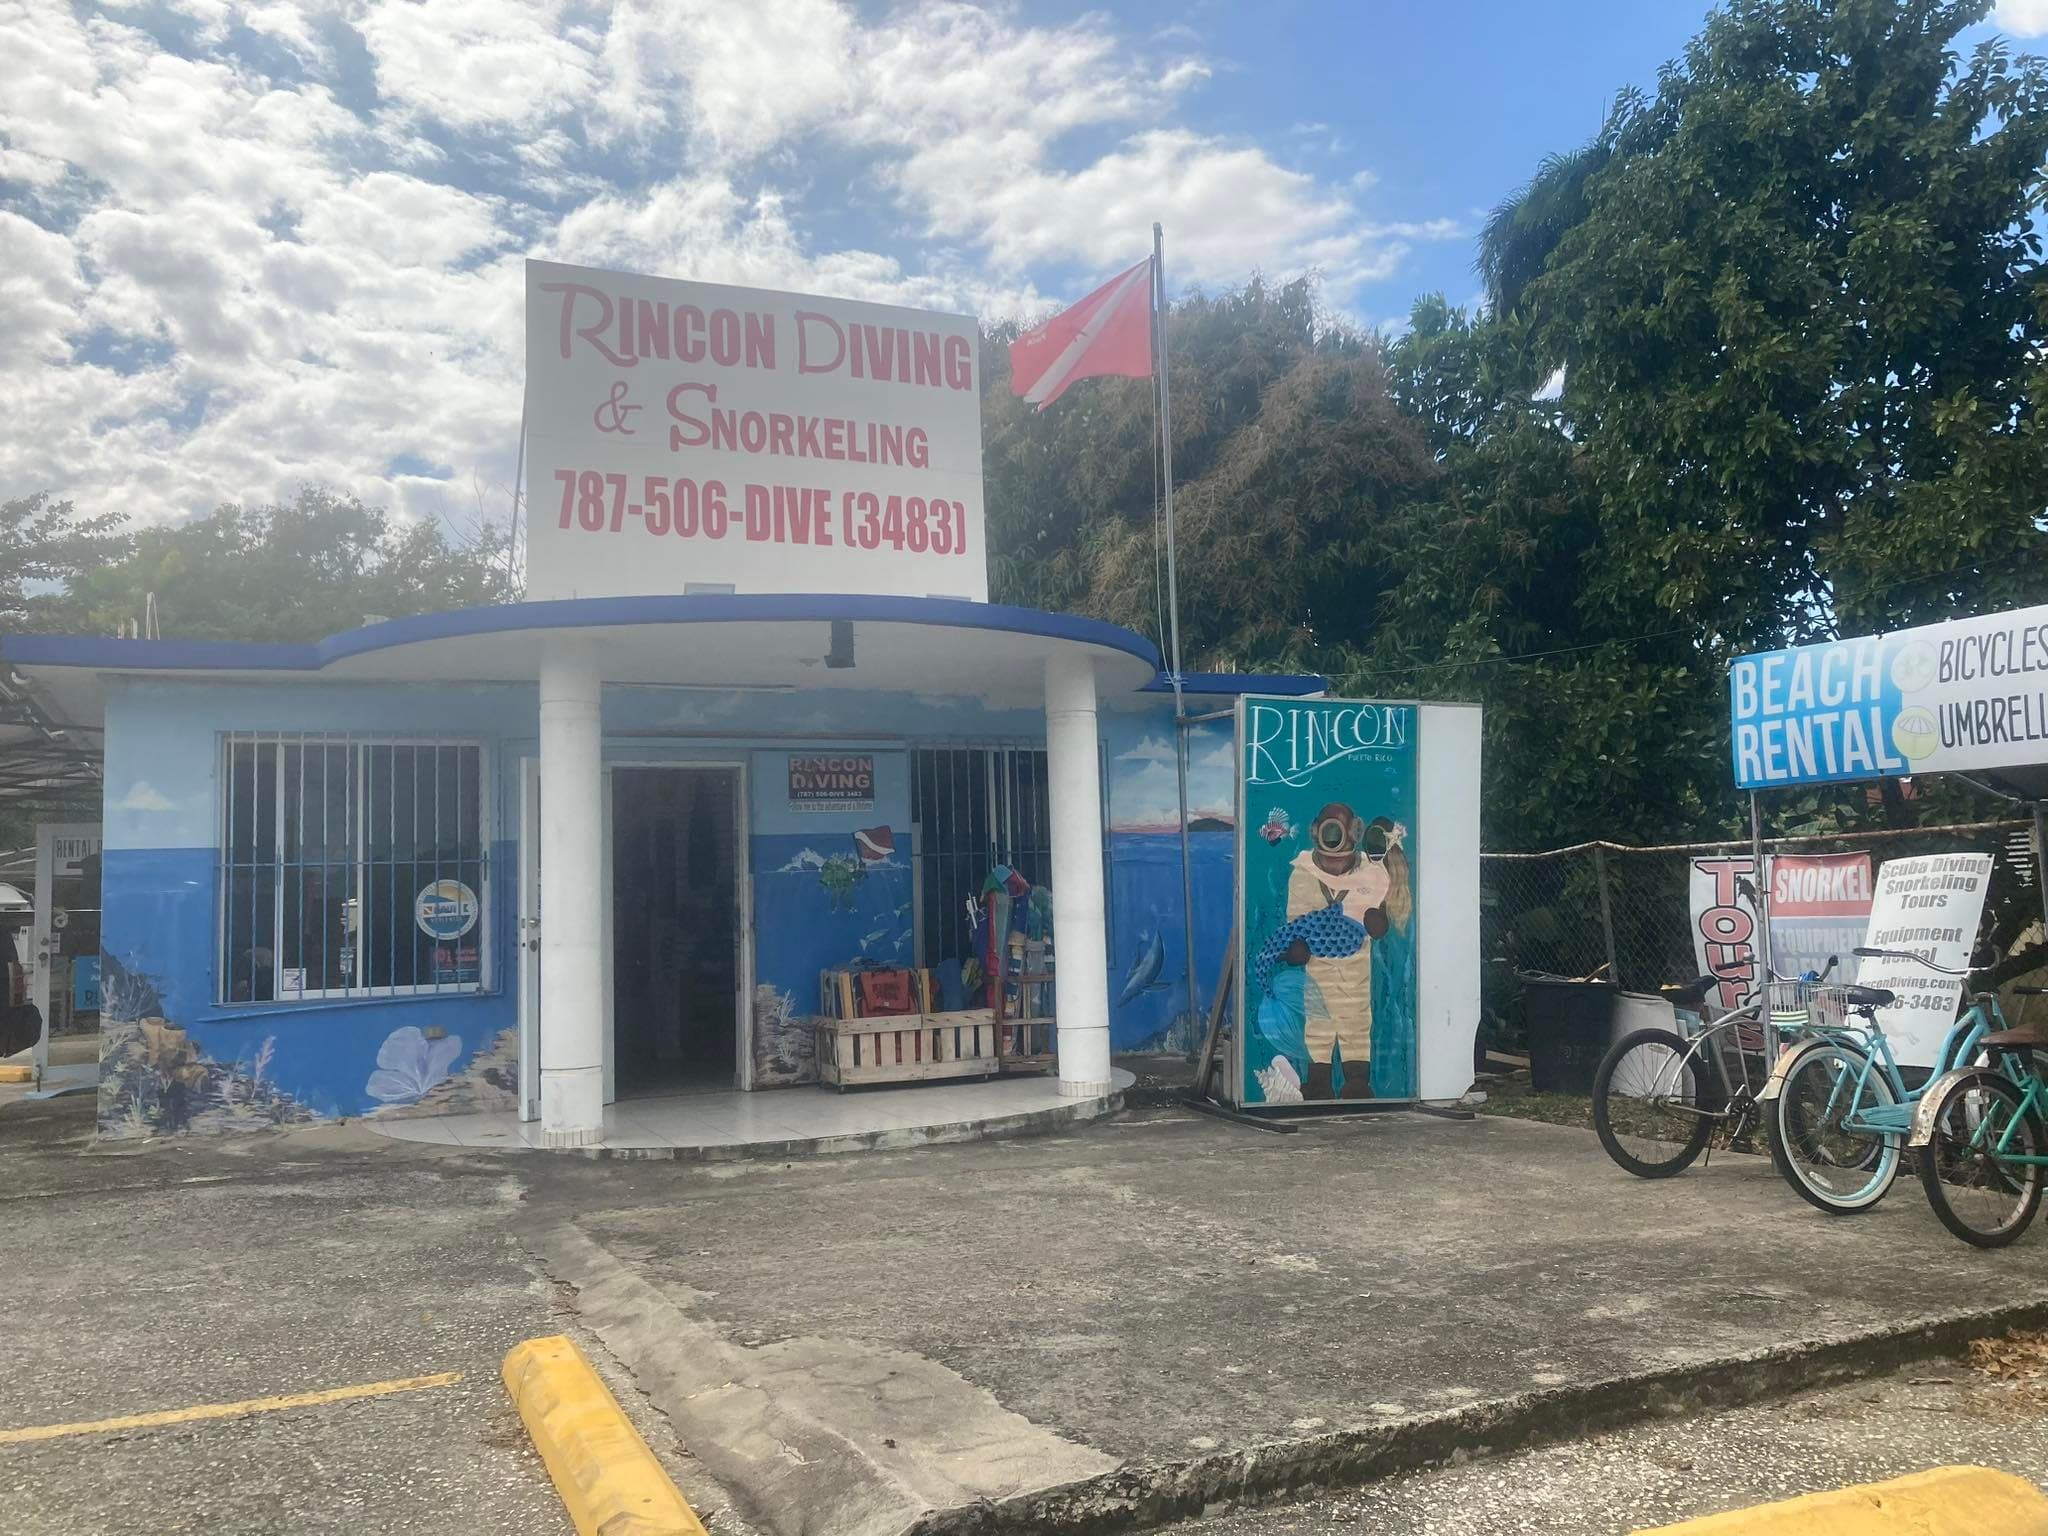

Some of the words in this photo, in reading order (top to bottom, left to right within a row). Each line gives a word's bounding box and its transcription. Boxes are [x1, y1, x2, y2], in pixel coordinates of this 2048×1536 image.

[538, 282, 776, 370] RINCON
[794, 310, 973, 391] DIVING
[594, 380, 643, 436] &
[666, 382, 930, 469] SNORKELING
[554, 469, 833, 547] 787-506-DIVE
[842, 491, 967, 556] (3483)
[1939, 624, 2048, 684] BICYCLES
[1736, 644, 1882, 720] BEACH
[789, 758, 873, 772] RINCON
[1246, 704, 1409, 788] RINCON
[1737, 706, 1903, 783] RENTAL
[791, 773, 870, 788] DIVING
[1775, 864, 1873, 905] SNORKEL
[1881, 860, 1929, 880] Scuba
[1931, 856, 1991, 875] Diving
[1886, 874, 1978, 895] Snorkeling
[1901, 894, 1949, 910] Tours
[1873, 926, 1963, 946] Equipment
